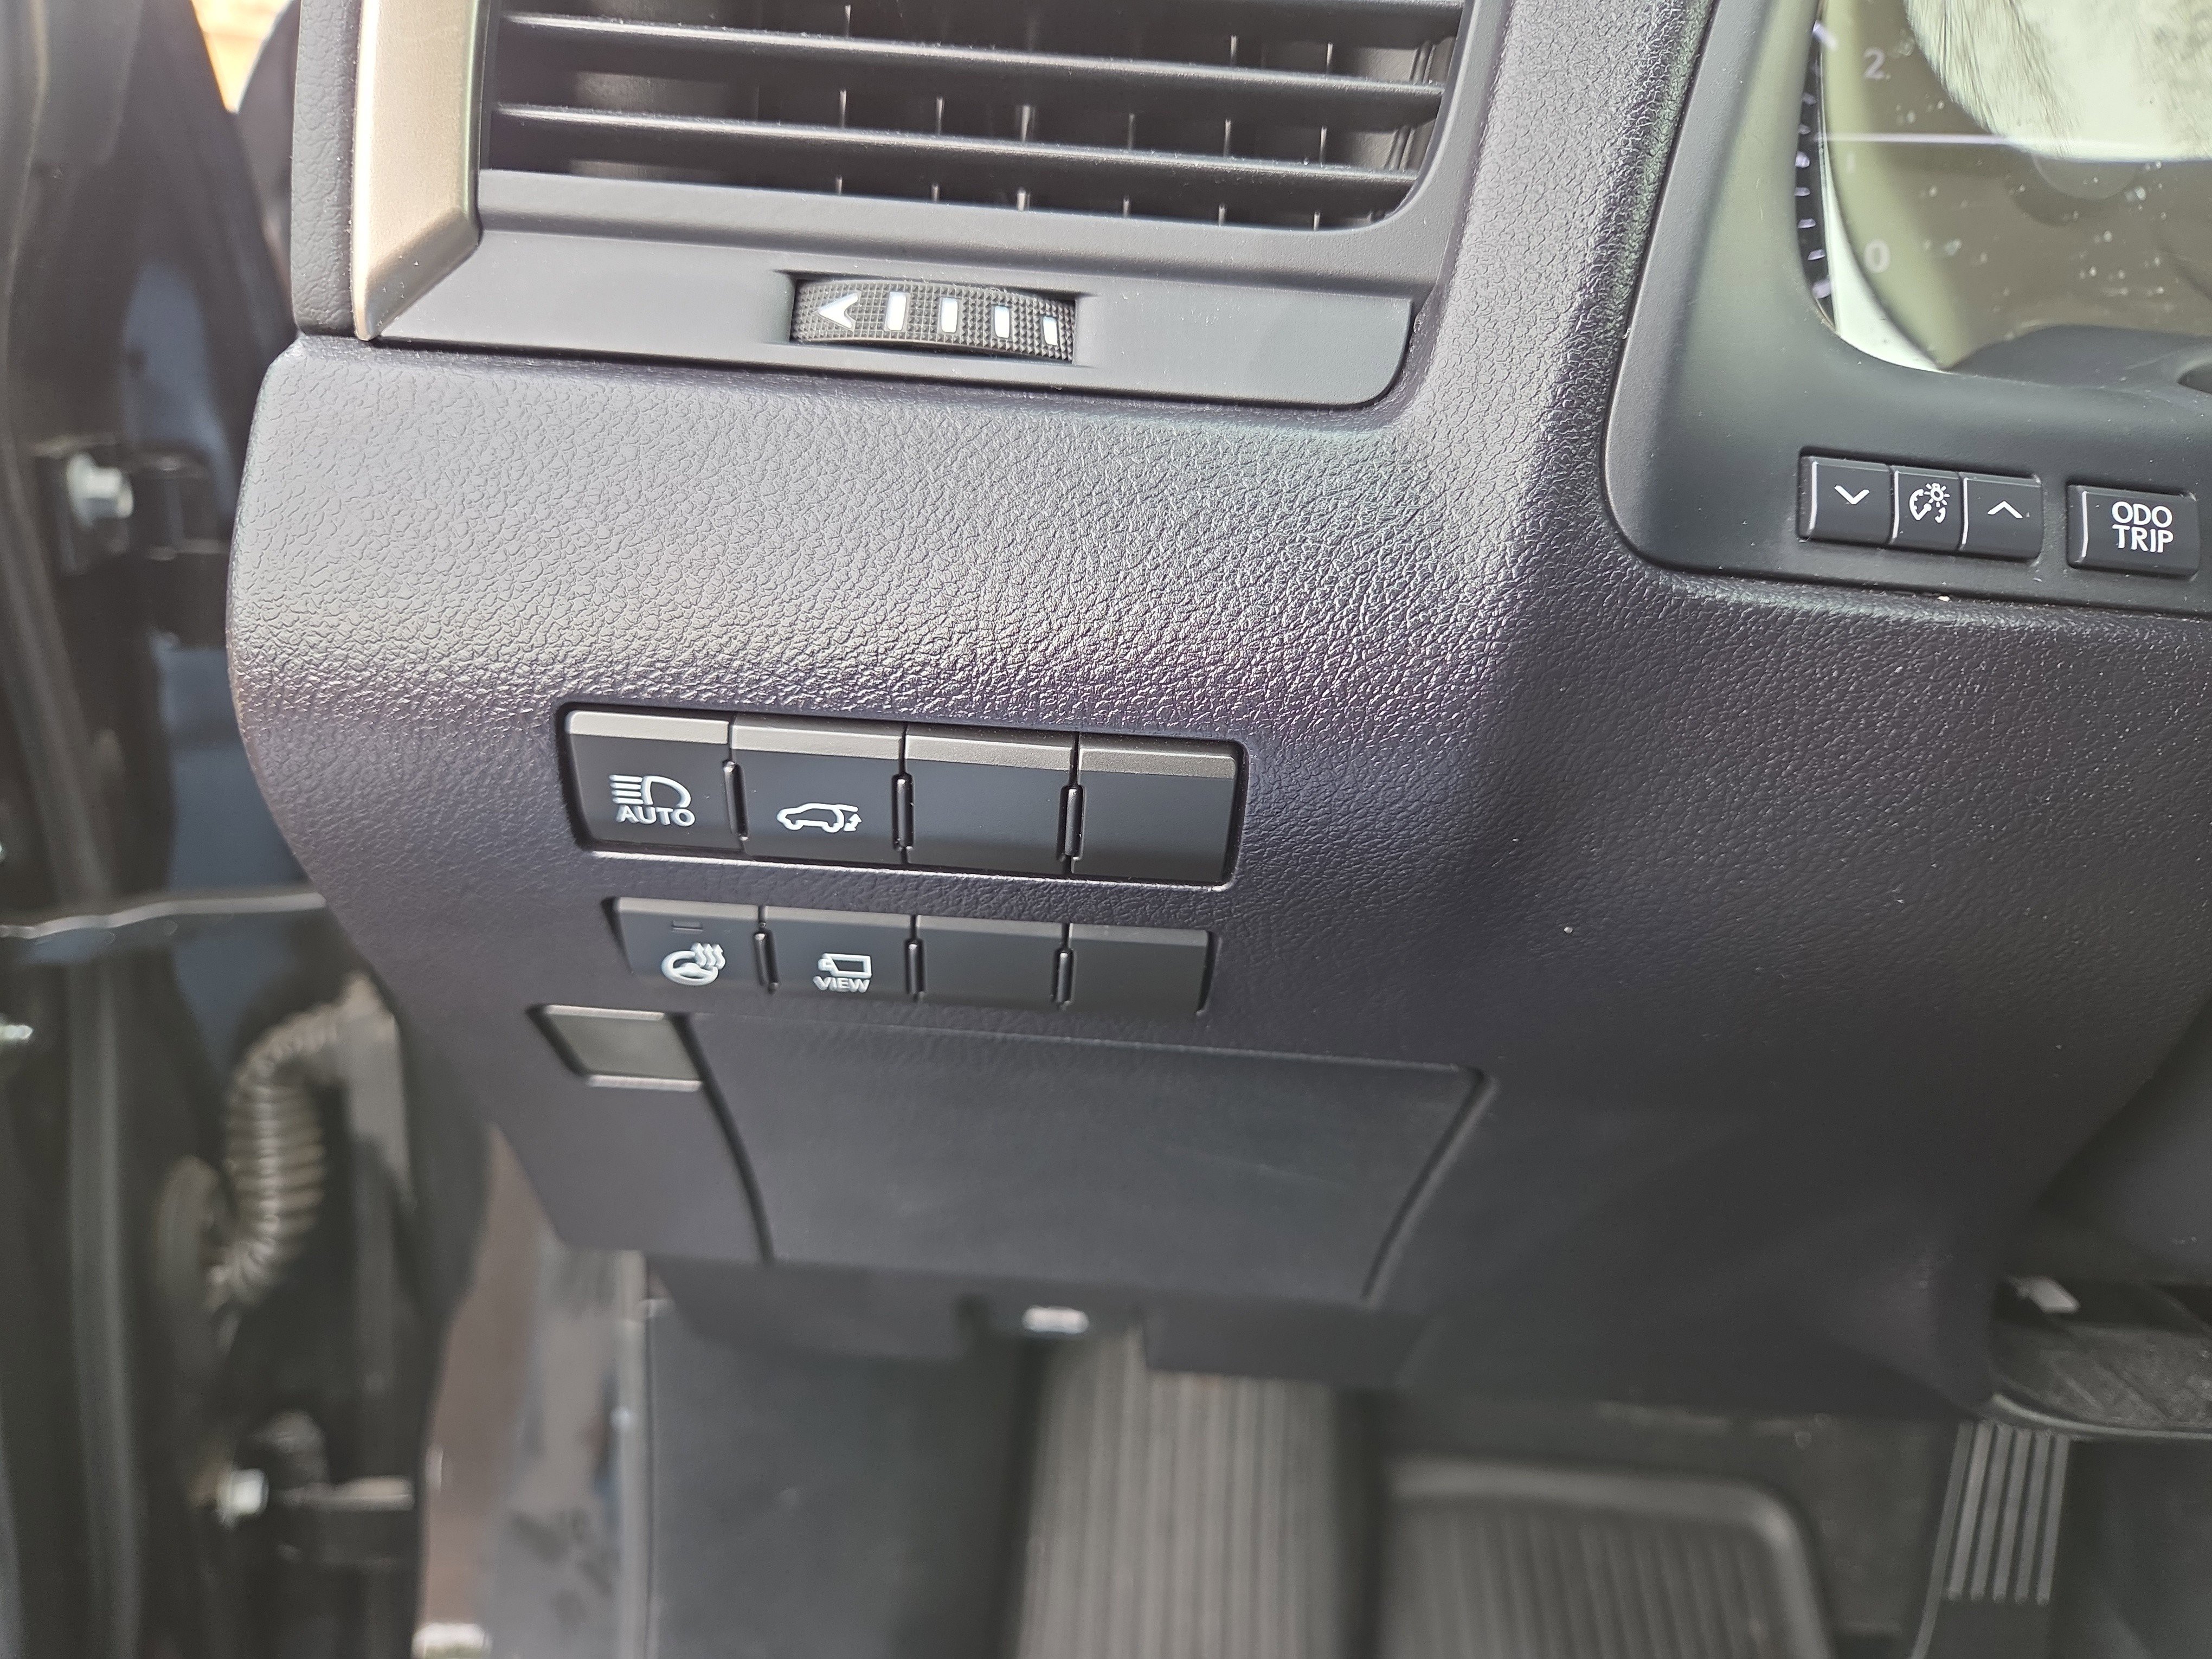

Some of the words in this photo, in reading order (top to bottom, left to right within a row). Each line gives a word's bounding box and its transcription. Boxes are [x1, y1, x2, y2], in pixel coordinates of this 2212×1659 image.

[1864, 47, 1886, 79] 2
[1864, 239, 1891, 274] 0
[2112, 501, 2172, 528] ODO
[2112, 524, 2174, 553] TRIP
[615, 805, 696, 827] AUTO
[813, 976, 870, 993] VIEW
